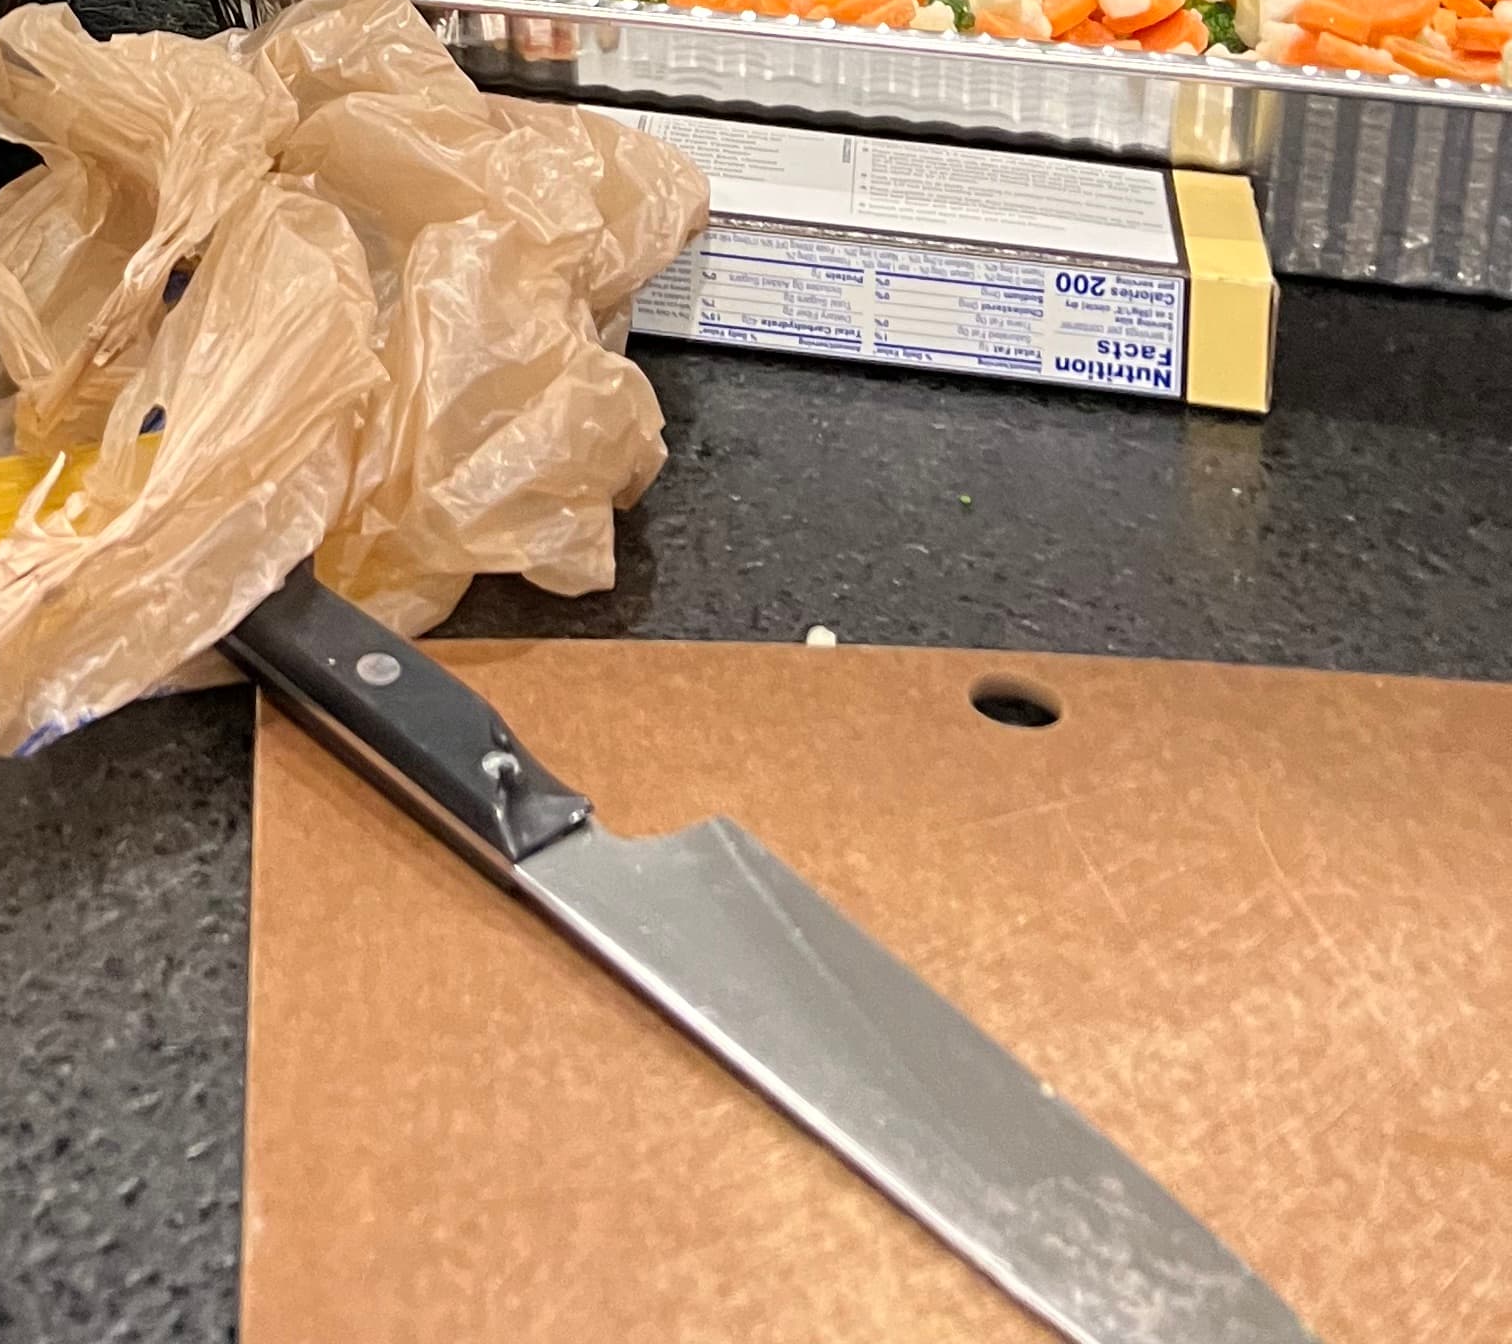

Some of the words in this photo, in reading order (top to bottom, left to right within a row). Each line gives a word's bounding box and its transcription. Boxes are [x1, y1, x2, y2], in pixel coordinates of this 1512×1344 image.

[1056, 272, 1106, 296] 200
[1111, 288, 1175, 305] Calories
[1097, 340, 1172, 366] Facts
[1055, 357, 1172, 388] Nutrition
